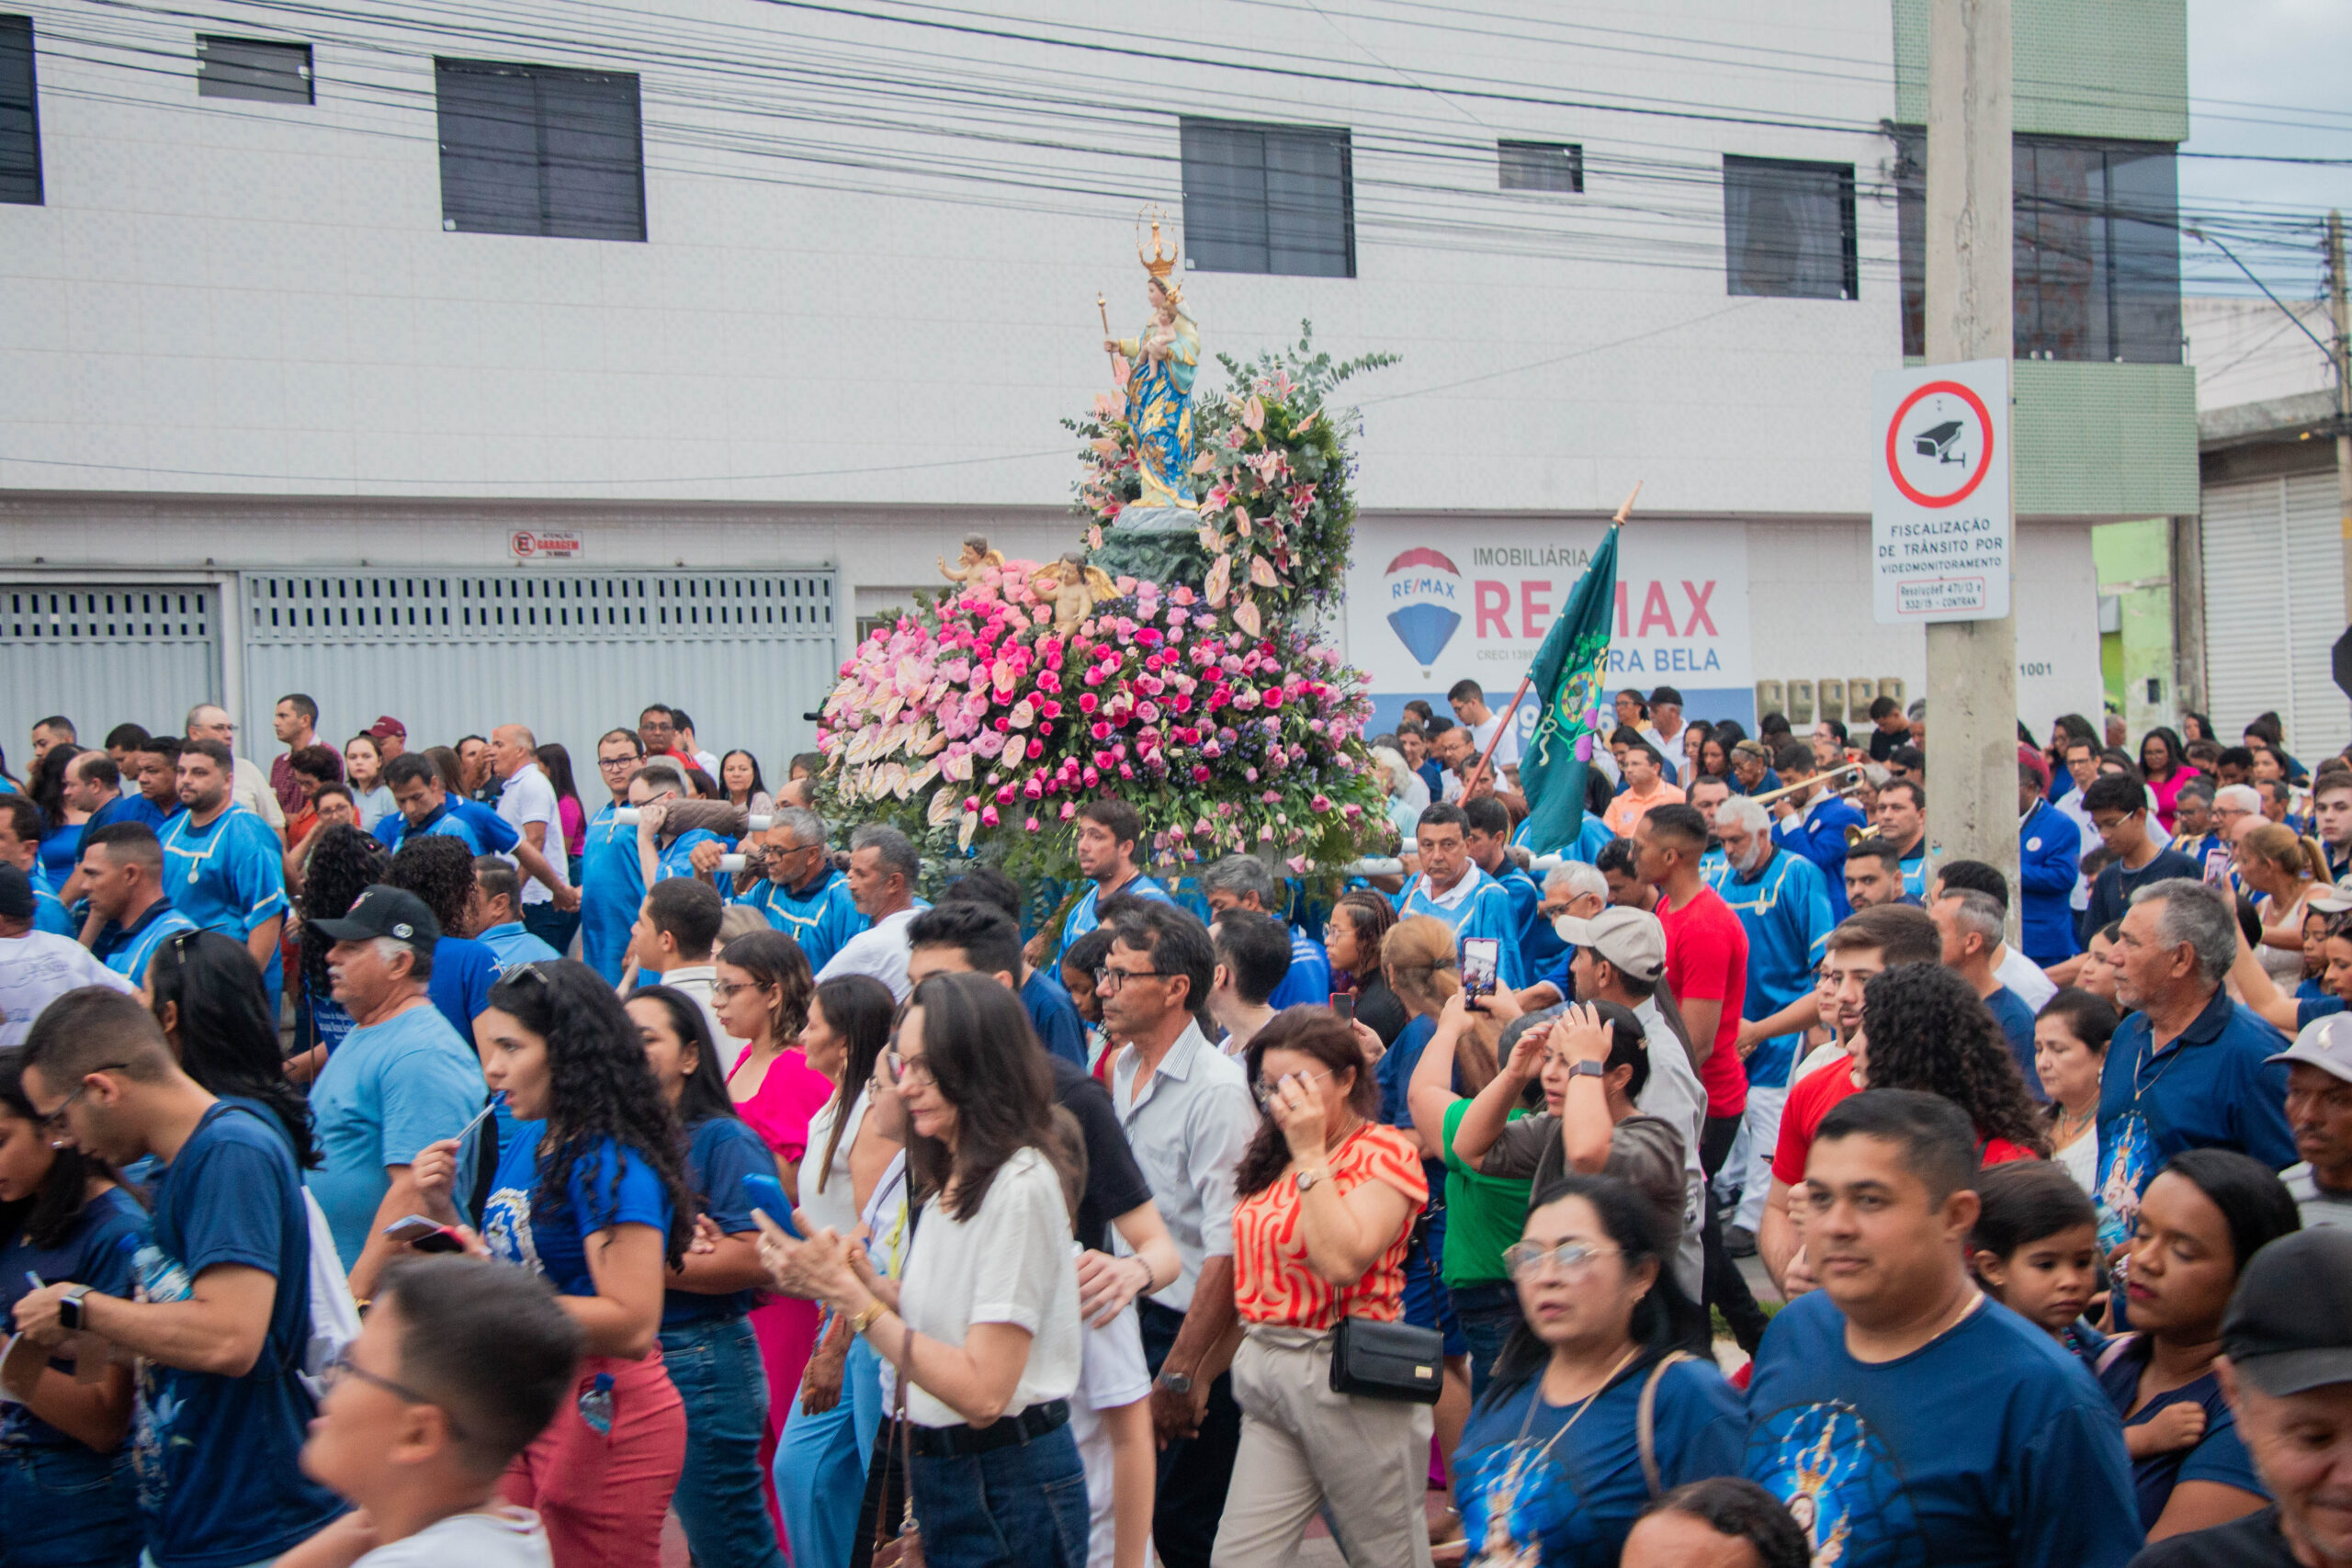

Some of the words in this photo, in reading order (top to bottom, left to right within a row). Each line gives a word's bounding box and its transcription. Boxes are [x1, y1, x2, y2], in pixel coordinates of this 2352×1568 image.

[1891, 518, 1991, 536] FISCALIZAÇÃO
[537, 539, 580, 550] GARAGEM
[1879, 544, 1895, 558] DE
[1904, 538, 1969, 556] TRÂNSITO
[1976, 537, 2003, 550] POR
[1473, 544, 1589, 567] IMOBILIÁRIA
[1881, 557, 2002, 573] VIDEOMONITORAMENTO
[1392, 578, 1455, 600] RE/MAX
[1942, 597, 1977, 607] CONTRAN
[1476, 649, 1509, 660] CRECI
[1655, 647, 1721, 671] BELA
[2019, 662, 2052, 676] 1001
